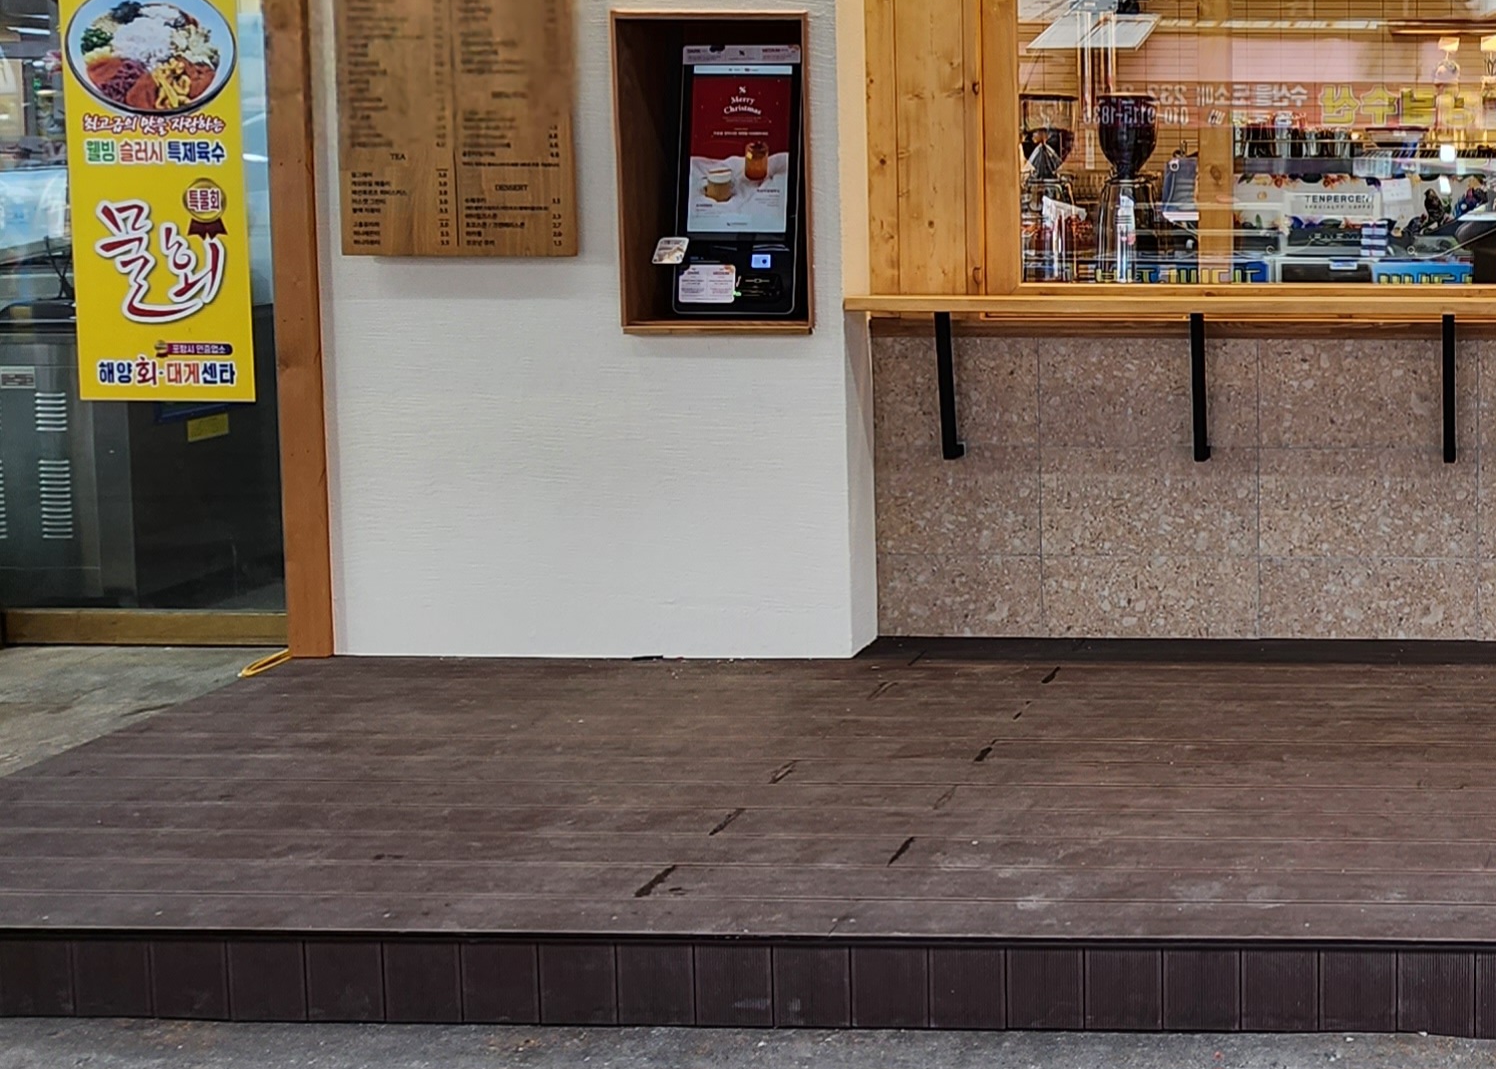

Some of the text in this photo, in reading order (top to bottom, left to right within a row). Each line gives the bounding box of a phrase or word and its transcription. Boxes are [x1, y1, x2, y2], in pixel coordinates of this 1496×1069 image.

[731, 95, 755, 106] Merry
[723, 104, 762, 115] Christmas
[84, 113, 226, 136] 최고급의 맛을 자랑하는
[86, 140, 225, 163] 웰빙 슬러시 특제육수
[390, 153, 406, 161] TEA
[187, 189, 221, 211] 특물회
[1304, 194, 1374, 203] TENPERCE
[97, 201, 223, 321] 물회
